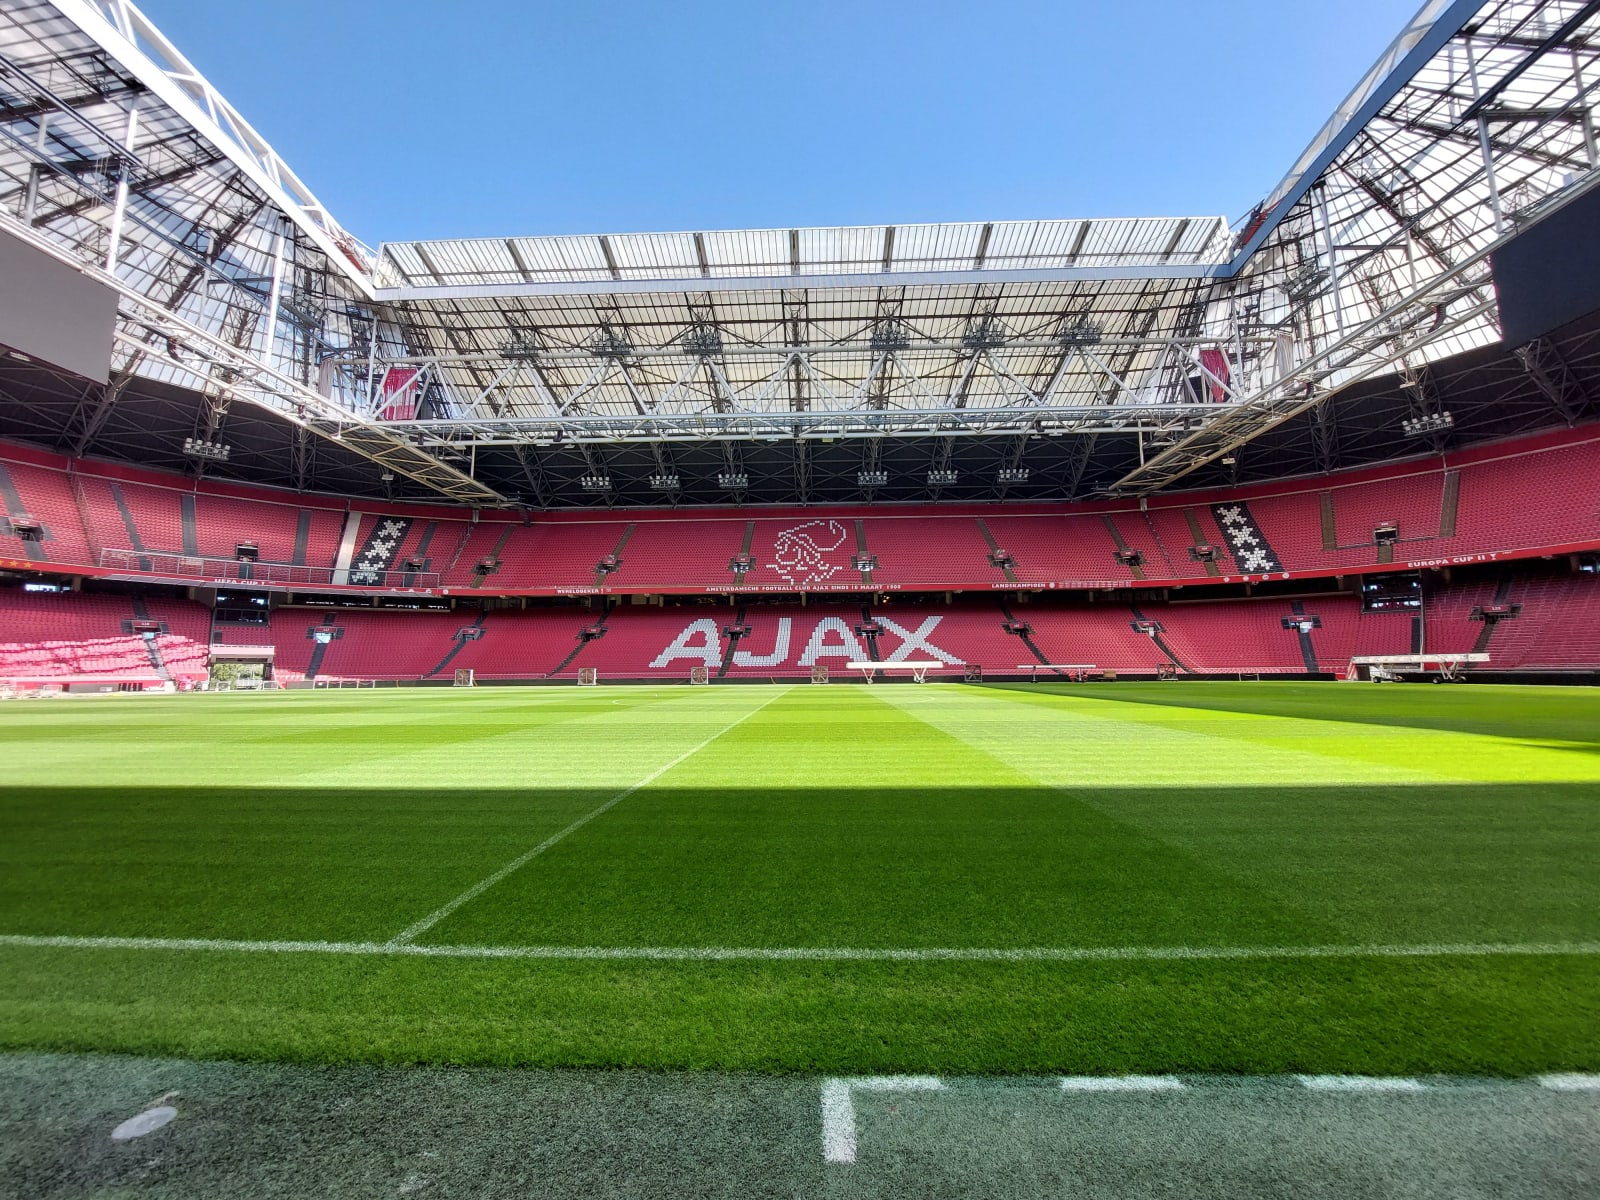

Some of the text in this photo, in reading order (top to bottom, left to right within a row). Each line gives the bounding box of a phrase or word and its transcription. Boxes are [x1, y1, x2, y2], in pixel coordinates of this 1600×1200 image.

[1408, 558, 1448, 568] EUROPA
[1452, 556, 1474, 564] CUP
[649, 616, 967, 668] AJAX
